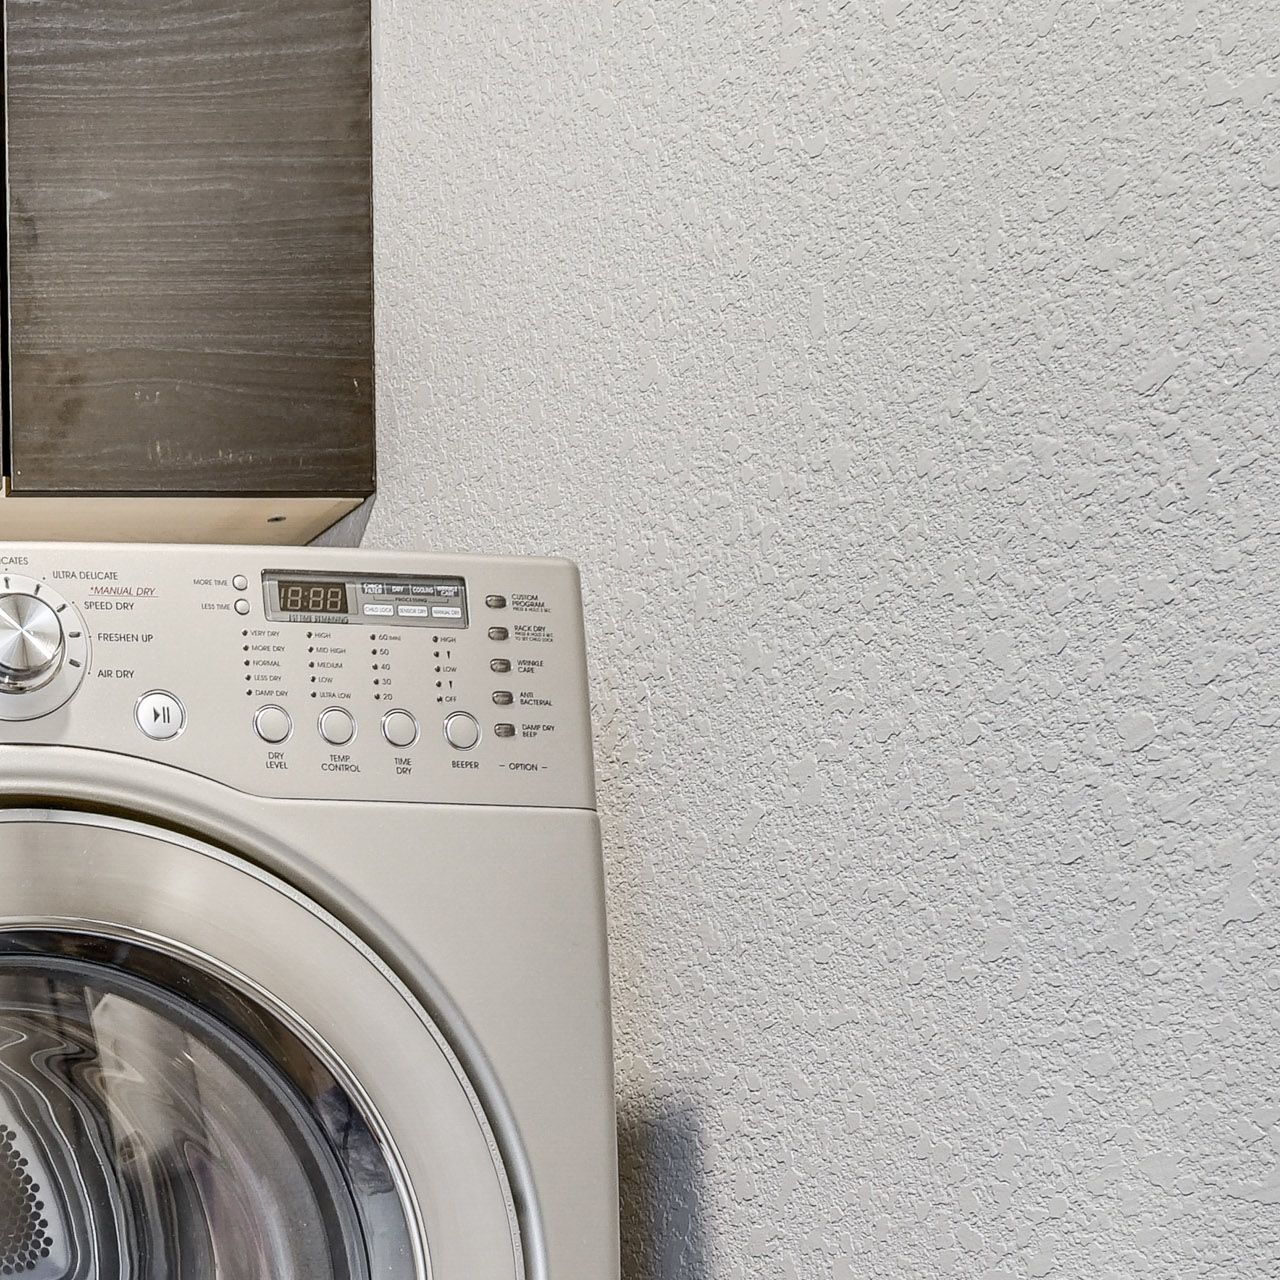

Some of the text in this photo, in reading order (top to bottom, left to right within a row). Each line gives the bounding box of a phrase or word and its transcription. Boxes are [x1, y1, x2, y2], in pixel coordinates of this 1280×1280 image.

[52, 570, 118, 580] ULTRA DELICATE
[136, 587, 156, 596] DRY
[84, 602, 134, 611] SPEED DRY
[98, 633, 153, 643] FRESHEN UP
[97, 669, 134, 679] AIR DRY
[268, 752, 284, 760] DRY
[330, 755, 350, 763] TEMP
[266, 761, 288, 770] LEVEL
[395, 758, 412, 766] TIME
[452, 761, 479, 769] BEEPER
[321, 763, 361, 773] CONTROL
[396, 766, 412, 775] DRY
[509, 763, 538, 771] OPTION
